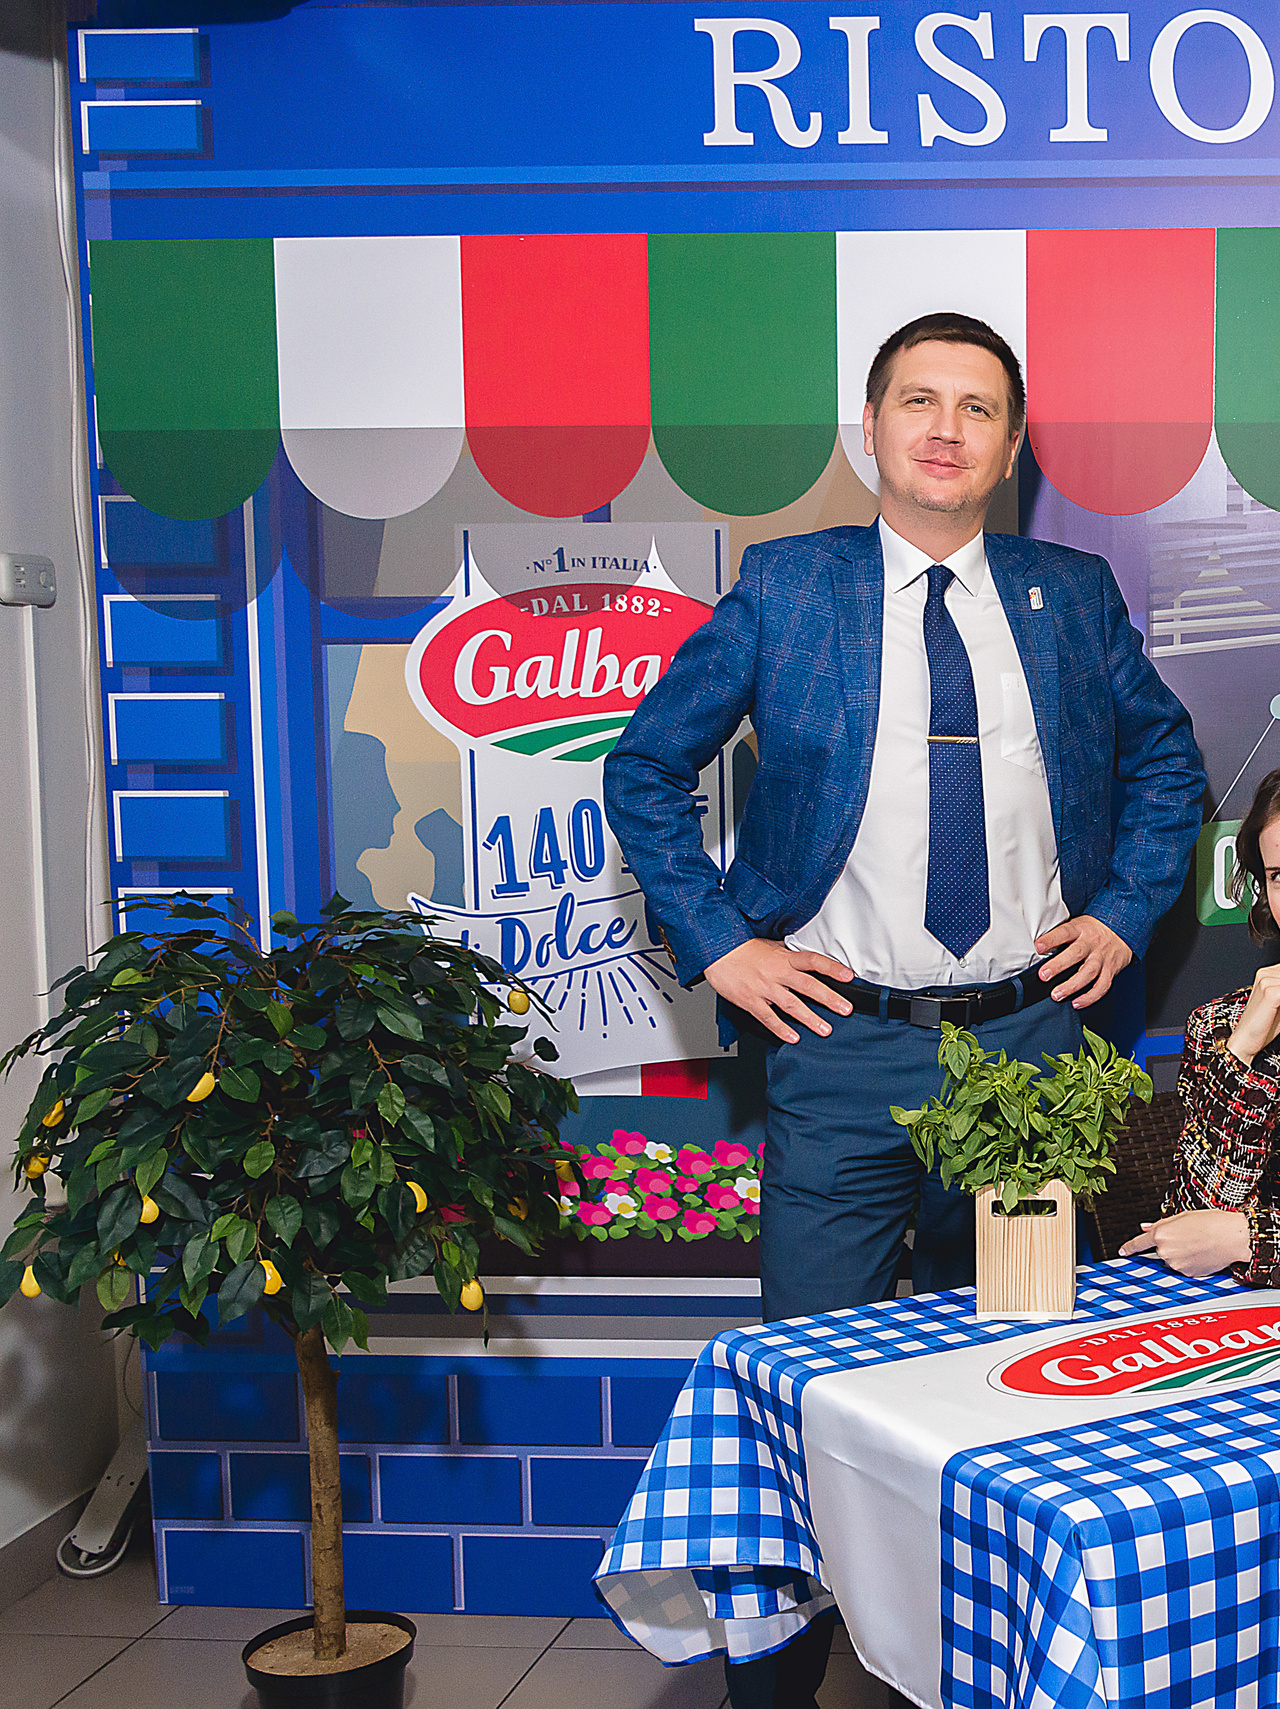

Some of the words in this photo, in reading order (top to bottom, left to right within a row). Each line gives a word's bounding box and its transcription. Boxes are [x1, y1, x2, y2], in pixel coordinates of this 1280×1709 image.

[571, 556, 586, 568] IN
[591, 556, 651, 573] ITALIA
[453, 627, 676, 705] Galba
[482, 798, 606, 899] 140
[495, 892, 637, 975] Dolce
